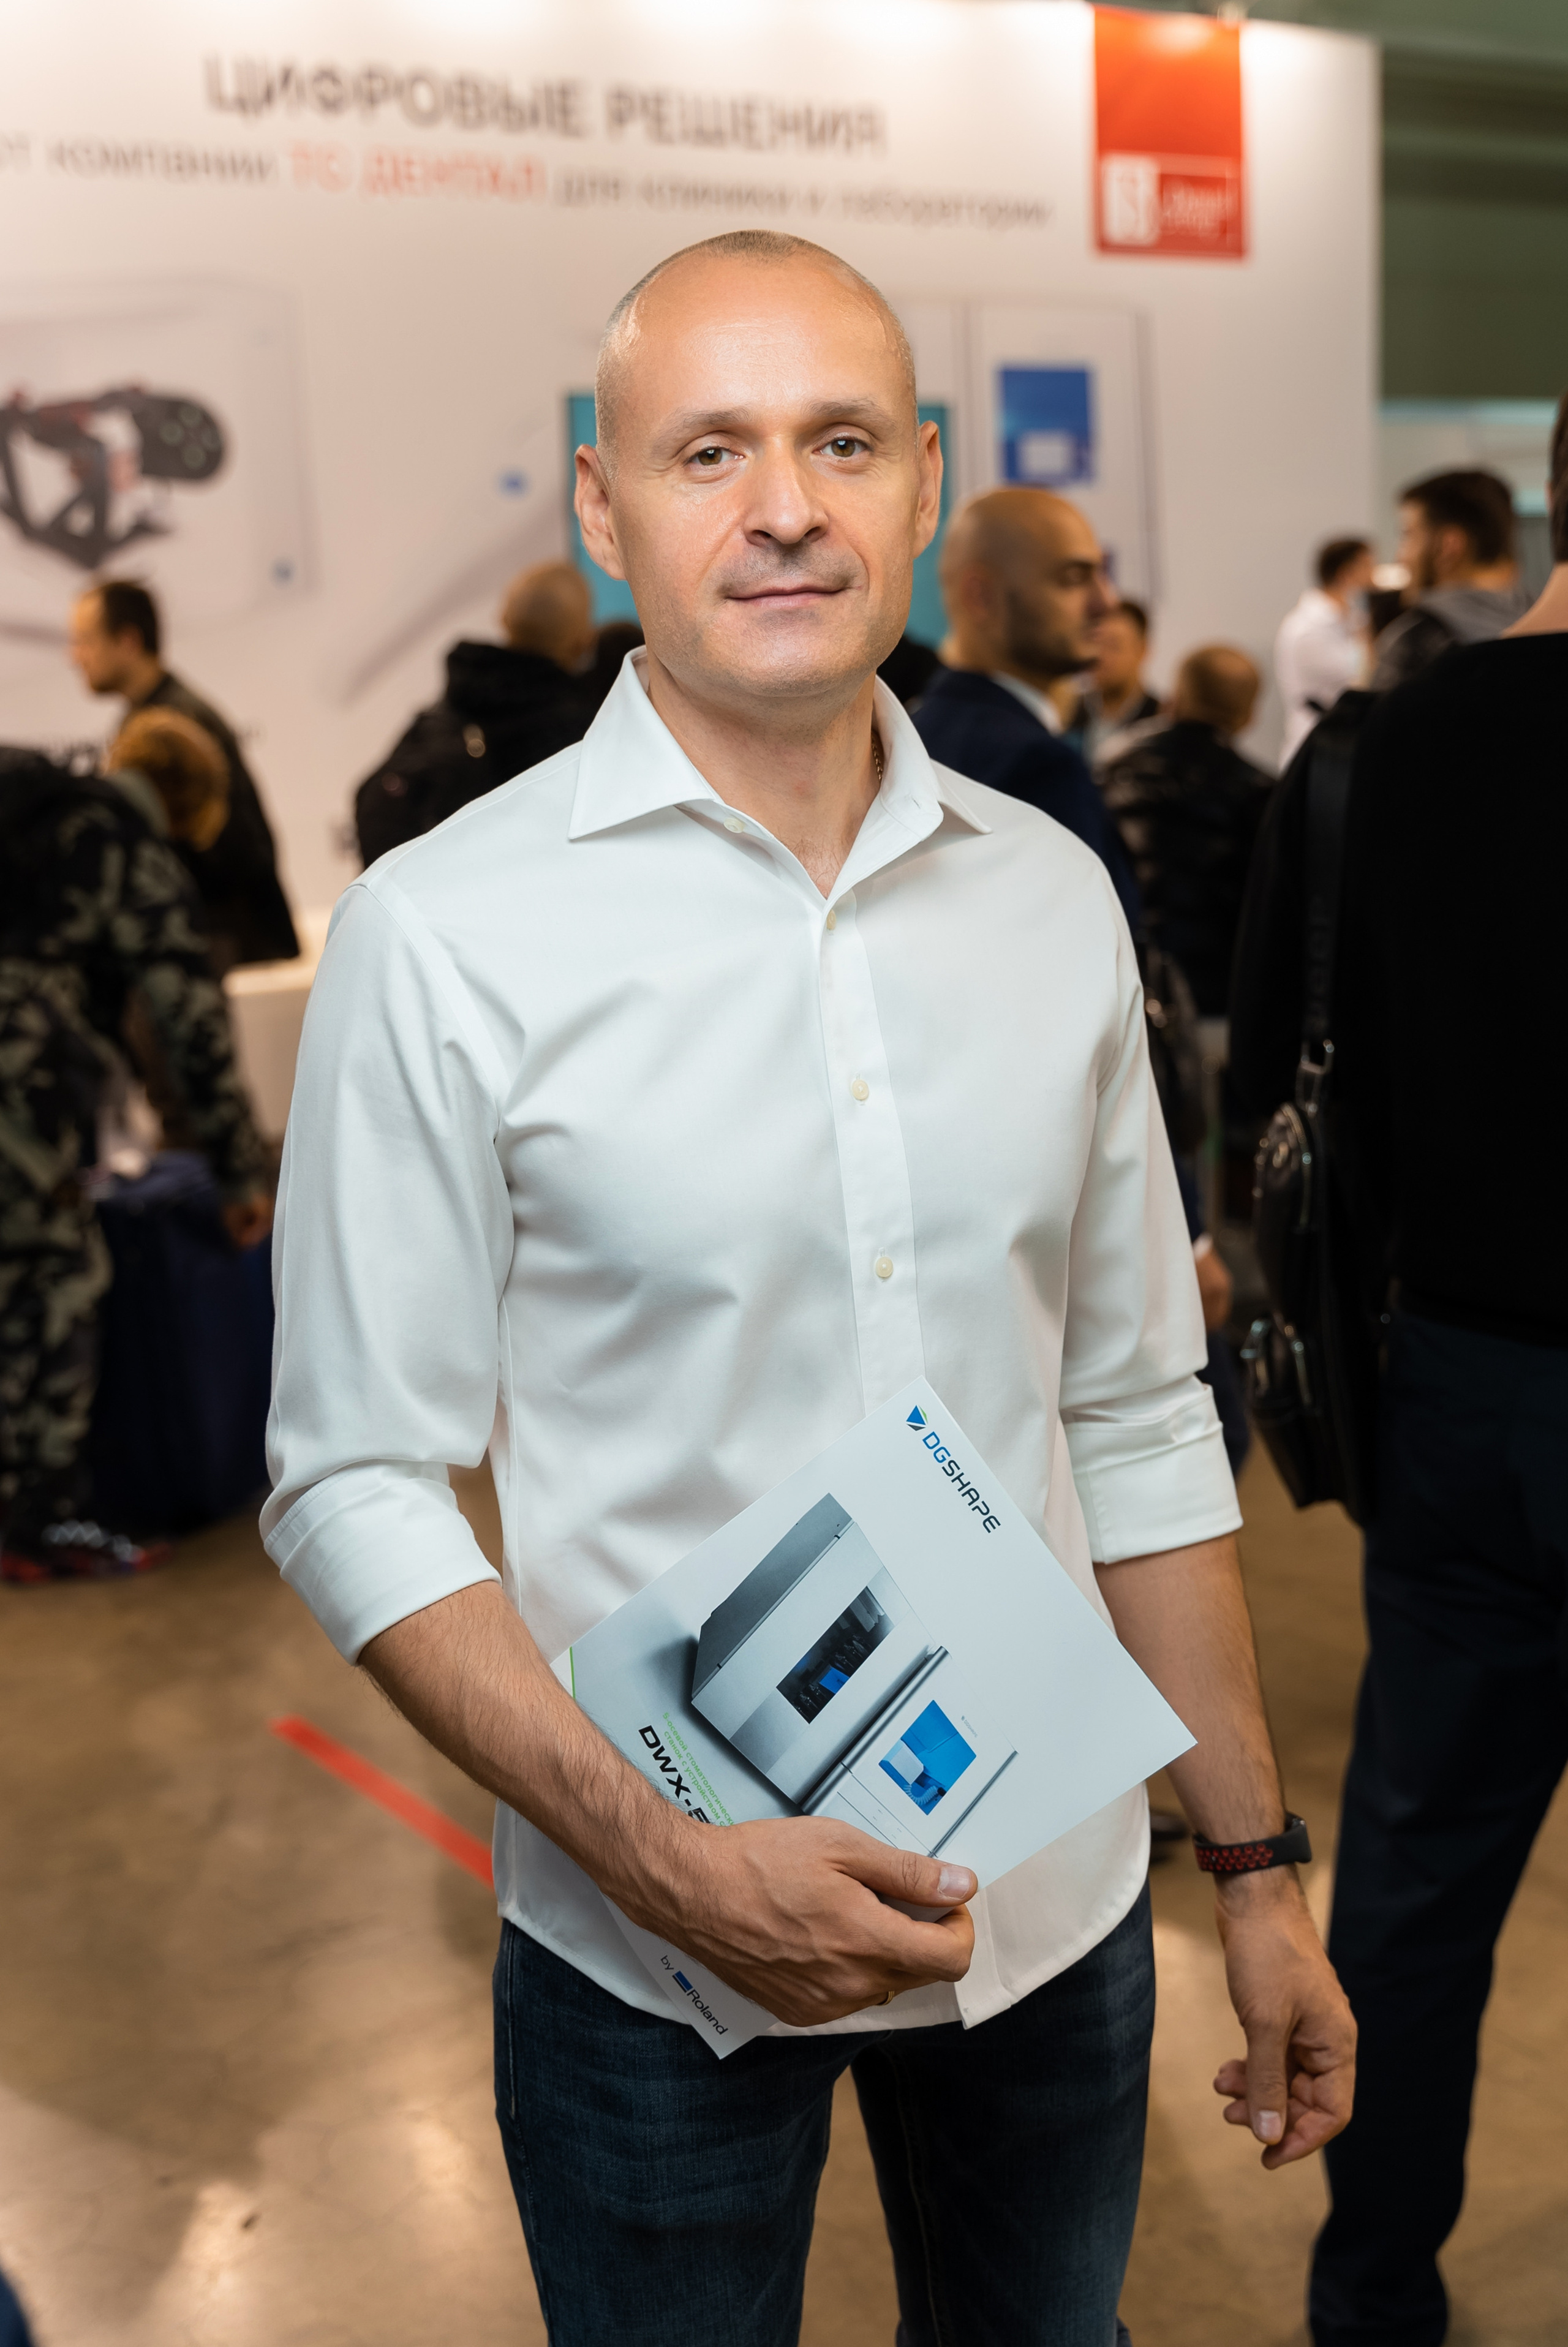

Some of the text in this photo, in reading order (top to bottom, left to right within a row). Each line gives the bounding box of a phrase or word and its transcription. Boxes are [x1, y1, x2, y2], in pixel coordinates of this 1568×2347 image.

[203, 55, 888, 158] ЦИФРОВЫЕ РЕШЕНИЯ
[922, 1431, 1001, 1534] DGSHAPE
[663, 1712, 688, 1752] 5-осевой
[664, 1731, 684, 1760] станок
[684, 1766, 721, 1820] устройством
[660, 1955, 728, 2035] by Roland
